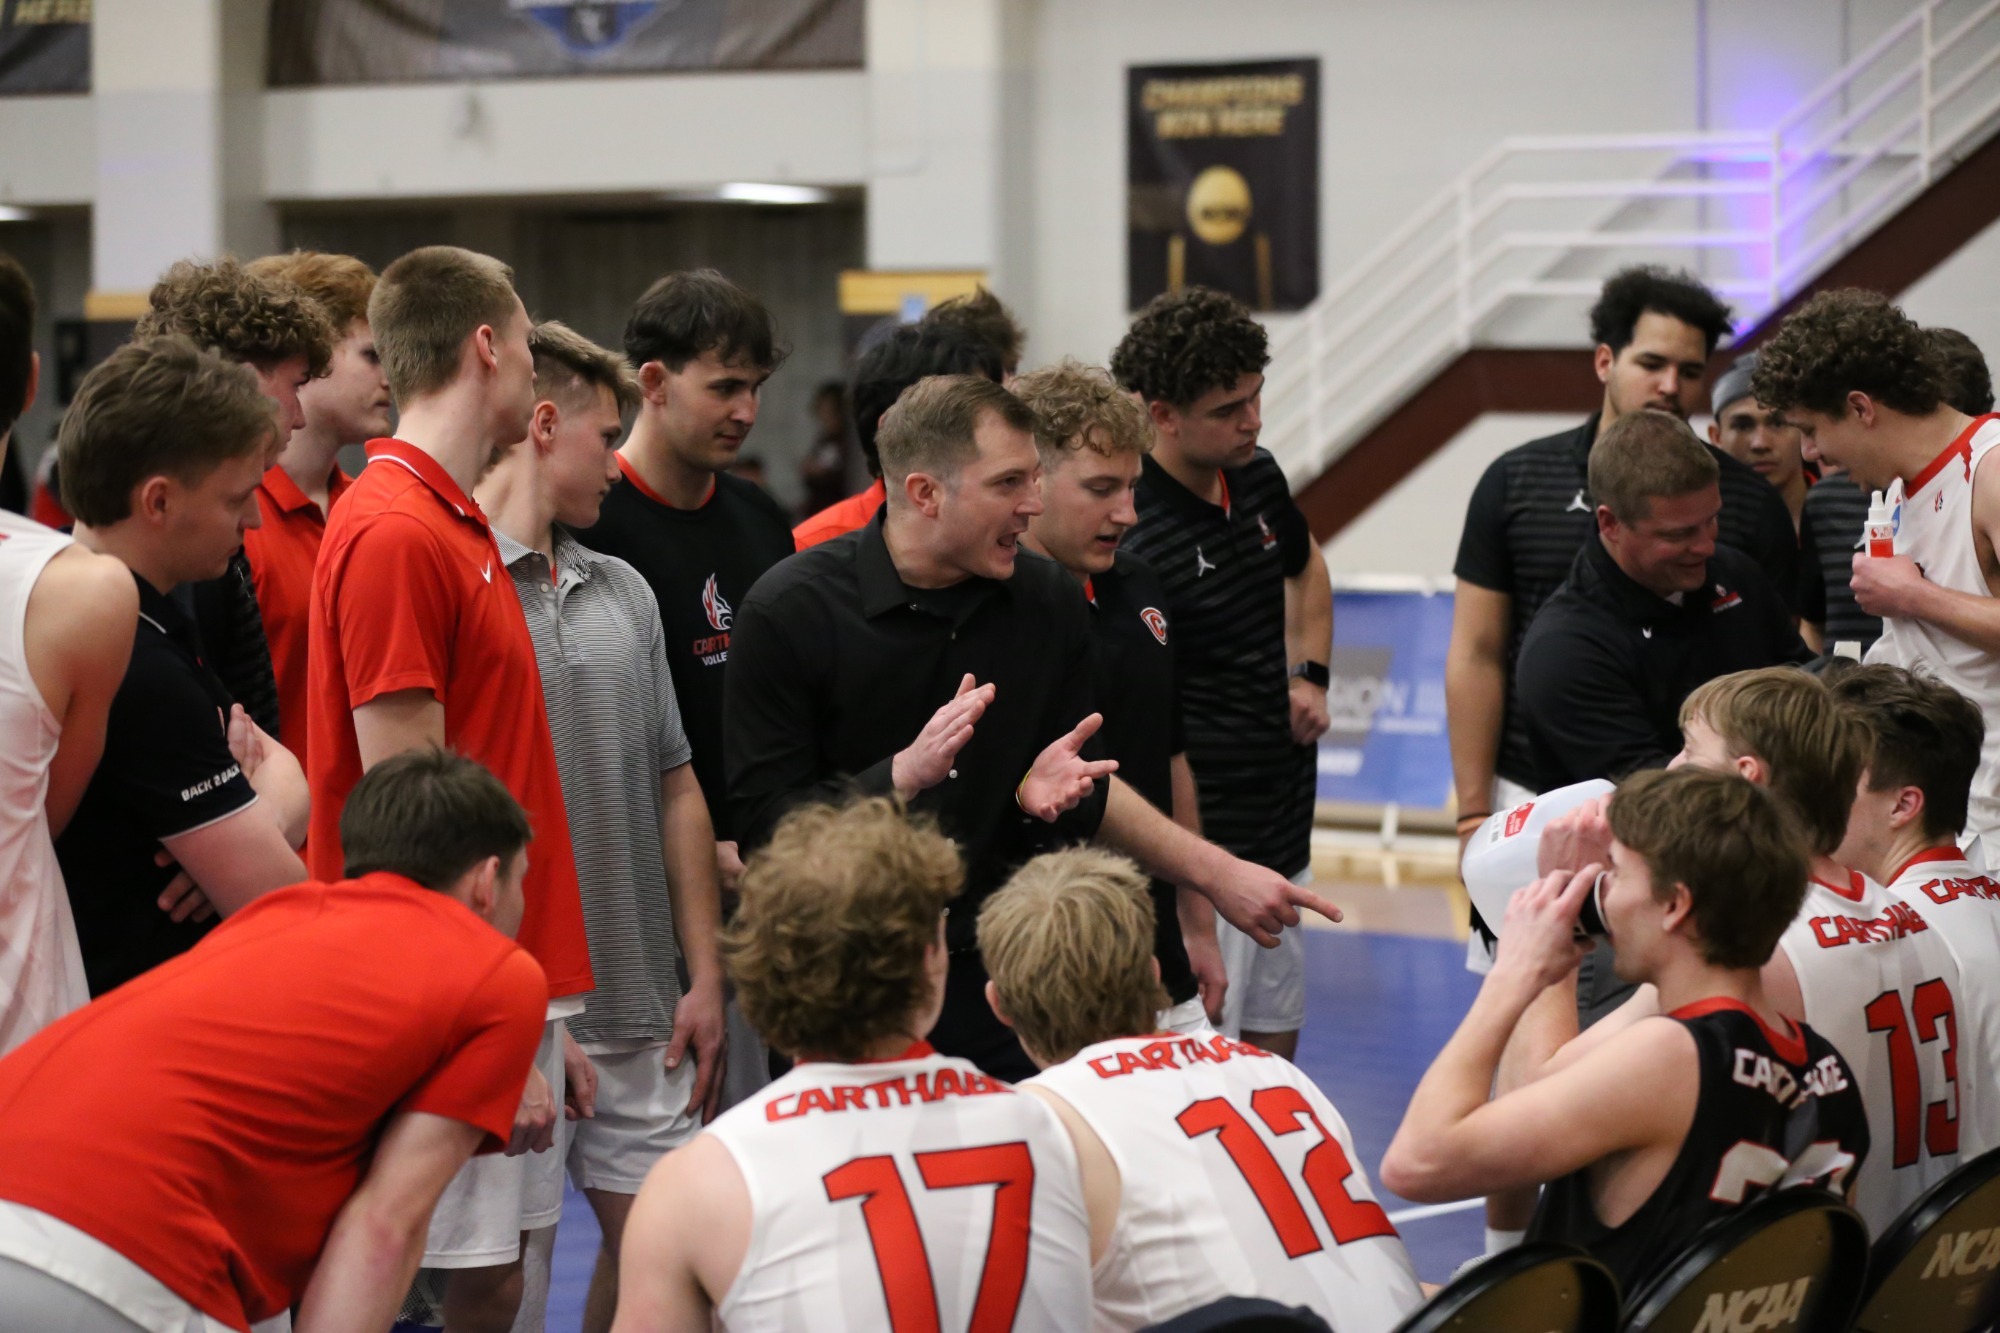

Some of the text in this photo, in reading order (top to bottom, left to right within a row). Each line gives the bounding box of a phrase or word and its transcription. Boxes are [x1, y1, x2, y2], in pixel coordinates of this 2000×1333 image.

[181, 779, 213, 801] BACK
[1864, 977, 1960, 1169] 13
[822, 1141, 1035, 1333] 17
[1175, 1086, 1400, 1259] 12
[1690, 1276, 1814, 1333] NCAA
